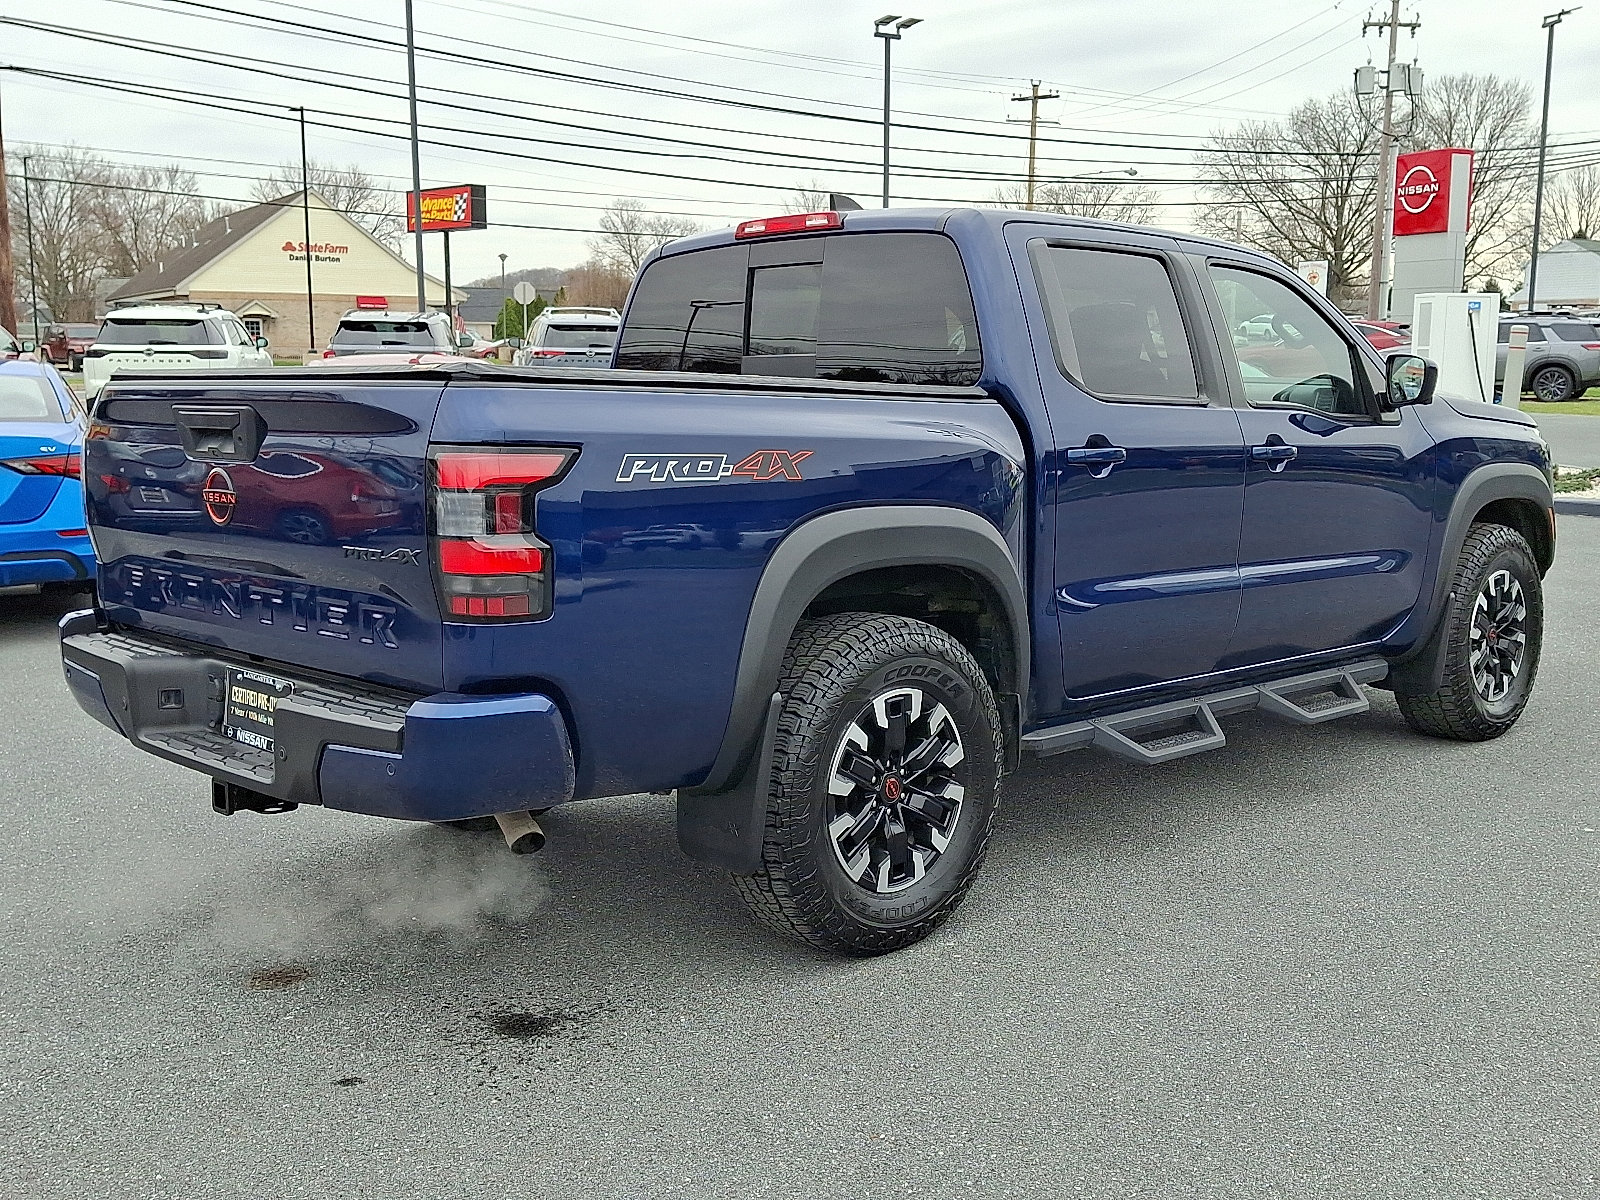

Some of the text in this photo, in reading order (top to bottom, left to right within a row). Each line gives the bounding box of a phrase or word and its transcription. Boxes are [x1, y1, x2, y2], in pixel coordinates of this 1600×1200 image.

[1397, 183, 1439, 196] NISSAN
[324, 243, 348, 254] Farm
[315, 255, 341, 263] Burton
[203, 491, 236, 504] NISSAN
[122, 562, 399, 650] FRONTIER
[884, 664, 965, 699] COOPER
[232, 686, 258, 708] CERTIFIED
[230, 706, 235, 714] 7
[234, 706, 246, 717] Year
[236, 730, 268, 750] NISSAN
